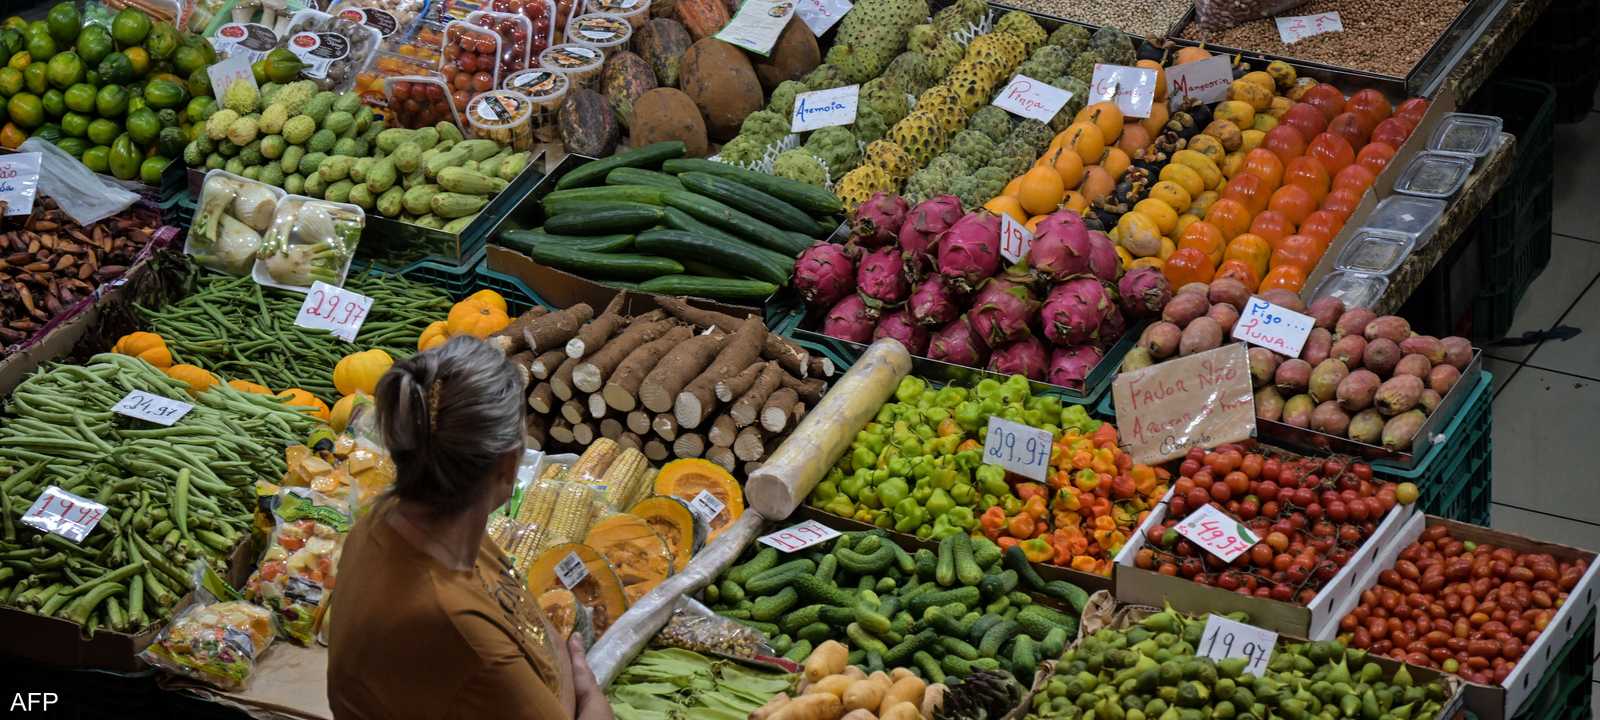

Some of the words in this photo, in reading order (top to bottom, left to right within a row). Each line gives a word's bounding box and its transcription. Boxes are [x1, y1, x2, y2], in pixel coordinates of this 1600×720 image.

[306, 289, 365, 326] 29,97
[989, 426, 1049, 467] 29,97
[769, 524, 829, 551] 19,97
[1197, 520, 1250, 556] 49,97
